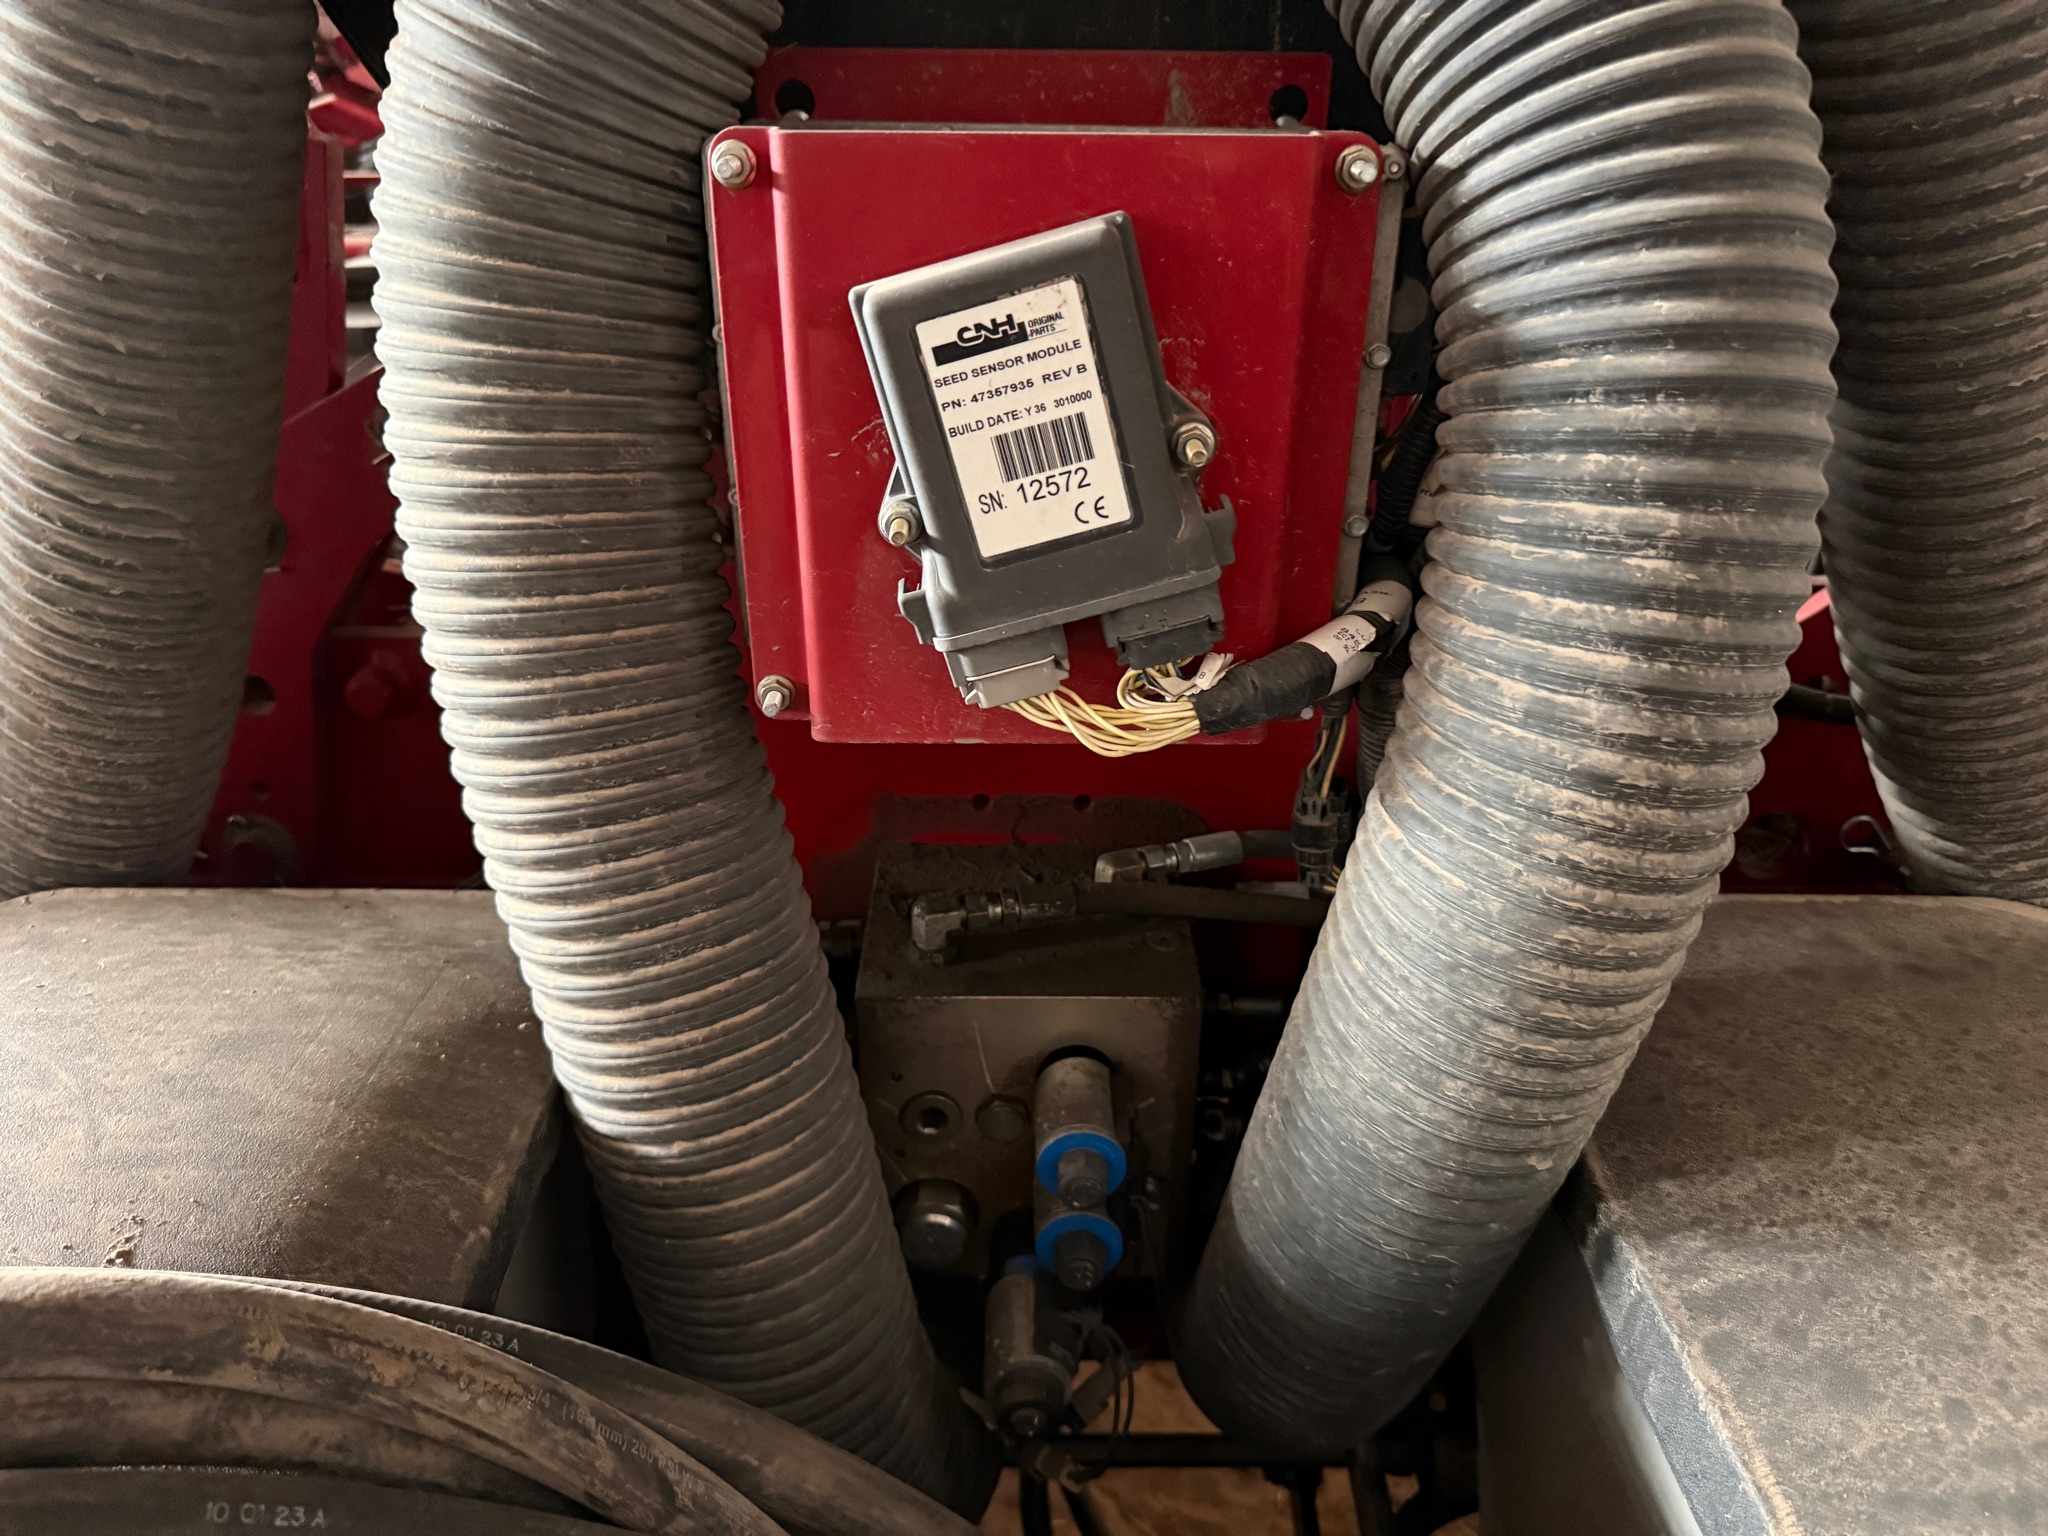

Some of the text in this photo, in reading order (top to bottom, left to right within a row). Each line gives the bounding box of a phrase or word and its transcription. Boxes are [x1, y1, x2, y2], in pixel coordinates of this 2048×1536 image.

[957, 313, 1016, 346] CNH
[1028, 311, 1065, 328] ORIGINAL
[1030, 324, 1056, 337] PARTS
[934, 338, 1082, 388] SEED SENSOR MODULE
[941, 363, 1088, 412] PN: 47357935 REV B
[948, 420, 984, 438] BUILD
[987, 410, 1023, 428] DATE:
[1053, 390, 1093, 408] 3010000
[978, 467, 1091, 515] SN: 12572
[1074, 495, 1109, 524] CE
[480, 1330, 504, 1347] 23
[205, 1501, 231, 1524] 10
[273, 1506, 305, 1527] 23
